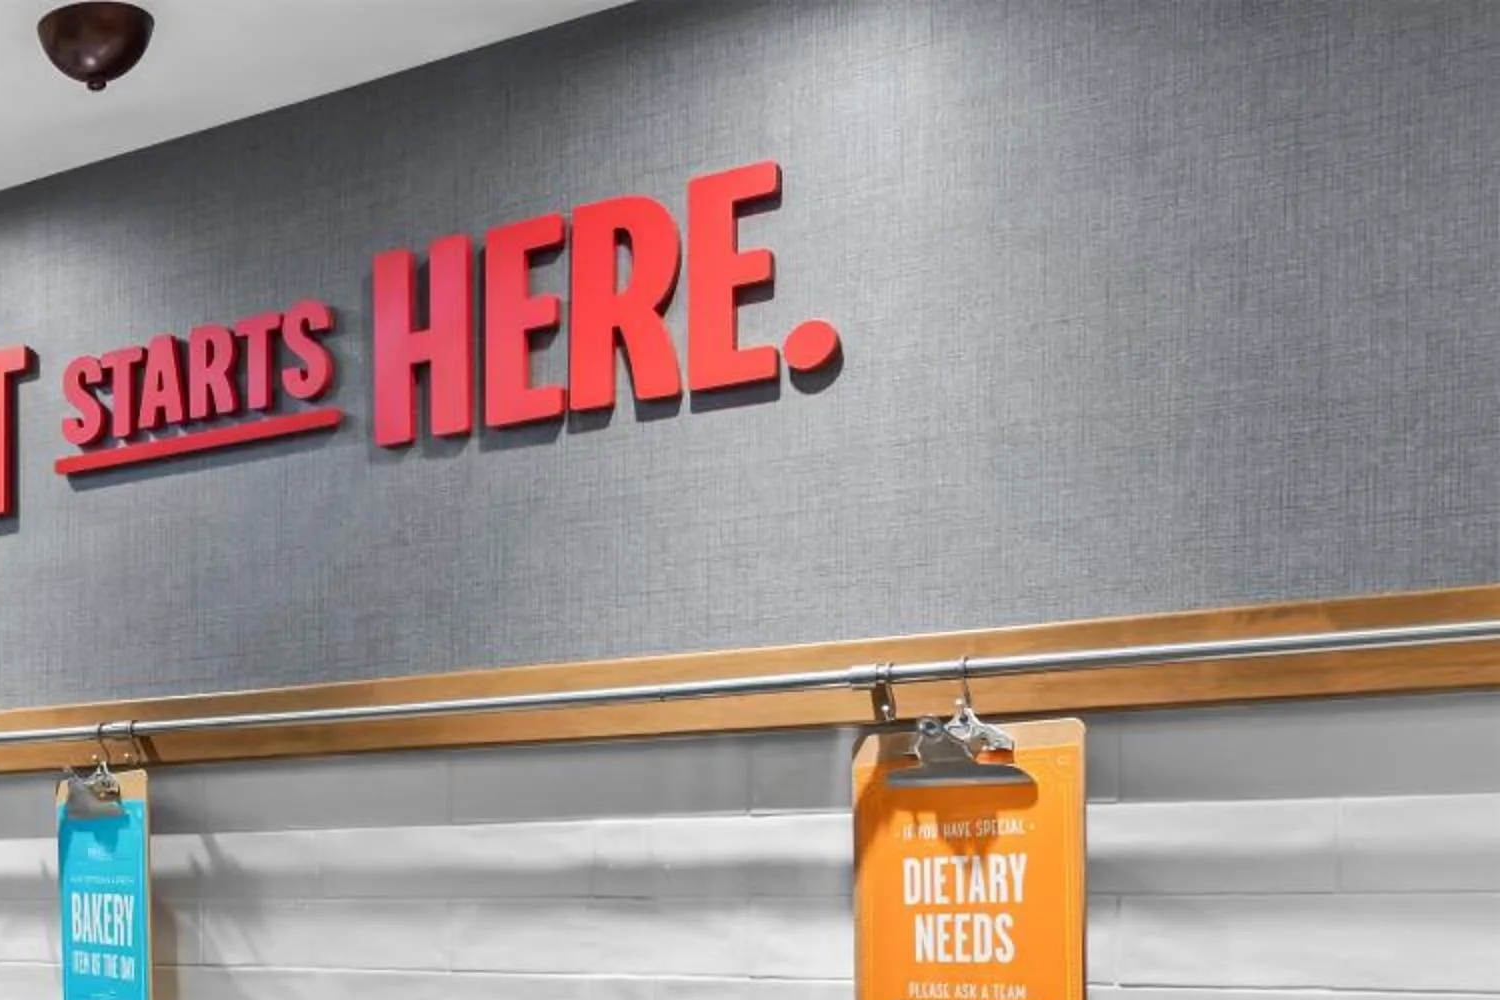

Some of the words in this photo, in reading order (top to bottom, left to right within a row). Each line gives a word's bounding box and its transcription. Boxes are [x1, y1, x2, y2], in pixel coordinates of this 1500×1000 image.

[62, 299, 334, 446] STARTS
[372, 159, 841, 448] HERE.
[943, 821, 972, 838] HAVE
[975, 817, 1026, 837] SPECIAL
[902, 852, 1028, 905] DIETARY
[71, 890, 136, 948] BAKERY
[914, 912, 1016, 964] NEEDS
[72, 949, 90, 976] ITEM
[91, 951, 102, 977] OF
[103, 953, 118, 979] THE
[120, 955, 135, 982] DAY
[908, 980, 950, 999] PLEASE
[953, 982, 977, 1000] ASK
[980, 983, 990, 1000] A
